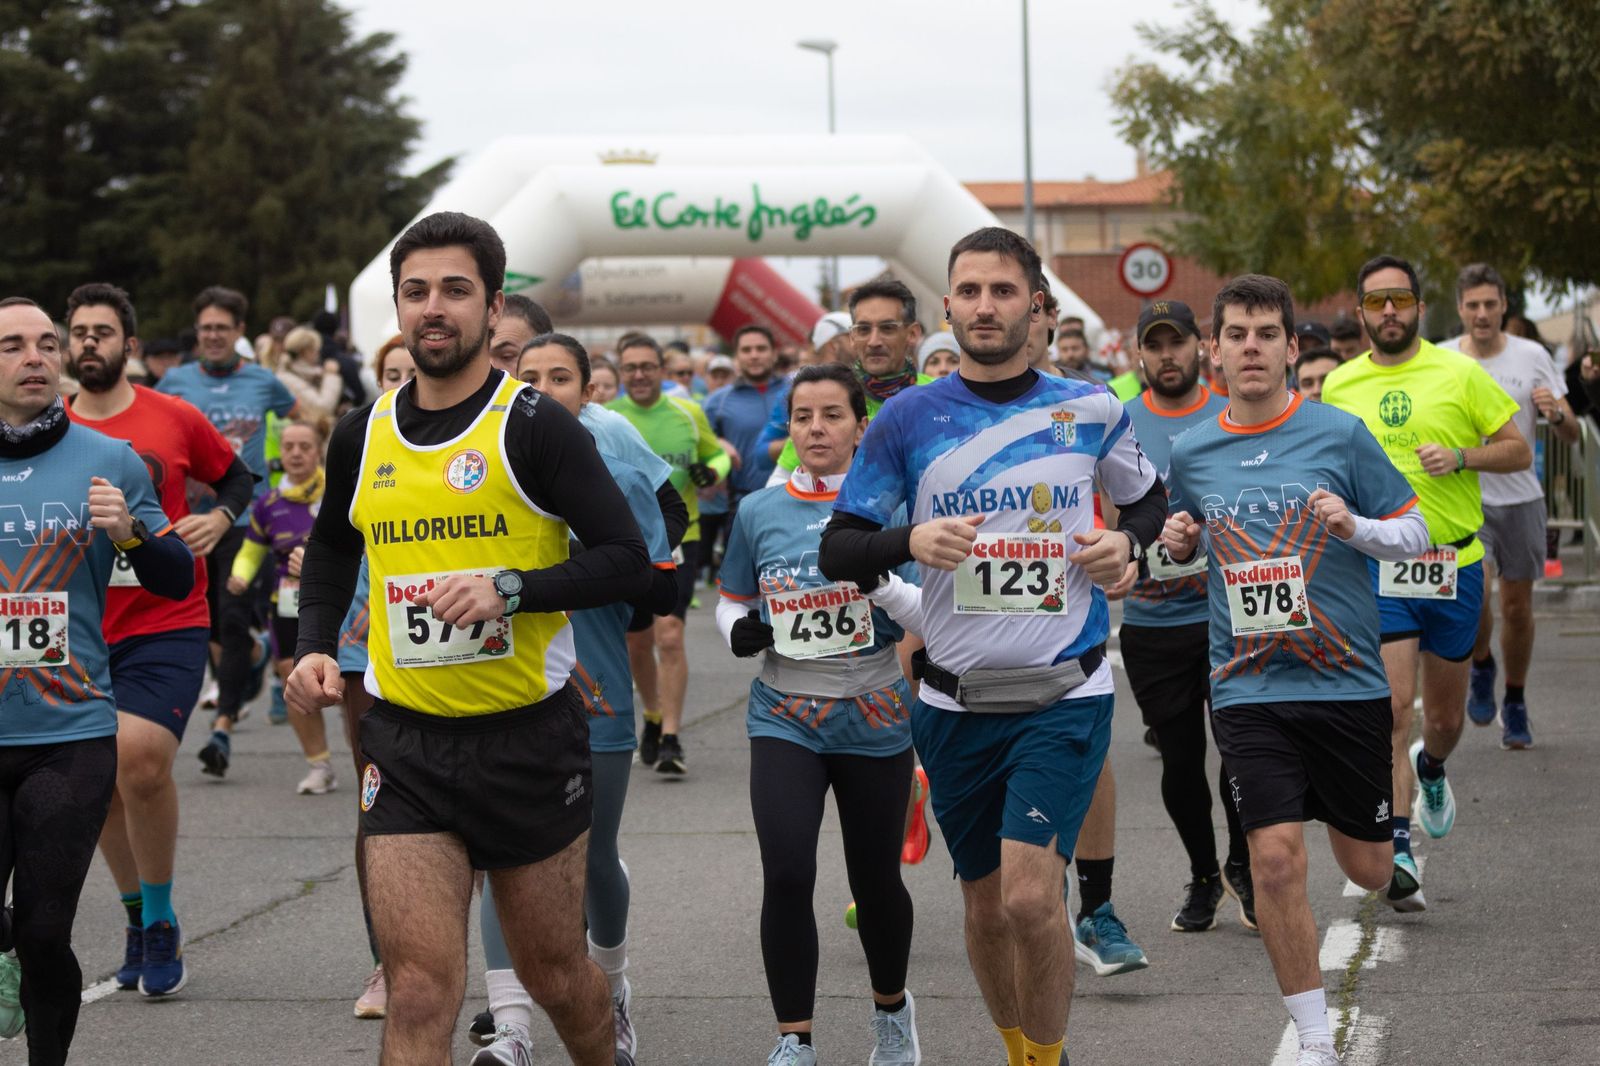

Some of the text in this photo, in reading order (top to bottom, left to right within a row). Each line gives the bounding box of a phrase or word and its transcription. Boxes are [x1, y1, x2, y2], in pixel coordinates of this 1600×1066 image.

[611, 183, 877, 241] El Corte Inglés
[1131, 261, 1162, 279] 30
[1241, 459, 1259, 467] MKA
[371, 513, 509, 545] VILLORUELA
[965, 538, 1064, 559] edunia
[975, 560, 1049, 596] 123
[1223, 561, 1302, 586] bedunia
[1393, 561, 1444, 586] 208
[0, 596, 66, 617] dunia
[769, 586, 865, 615] bedunia
[1240, 582, 1293, 617] 578
[4, 617, 51, 651] 18
[790, 605, 856, 643] 436
